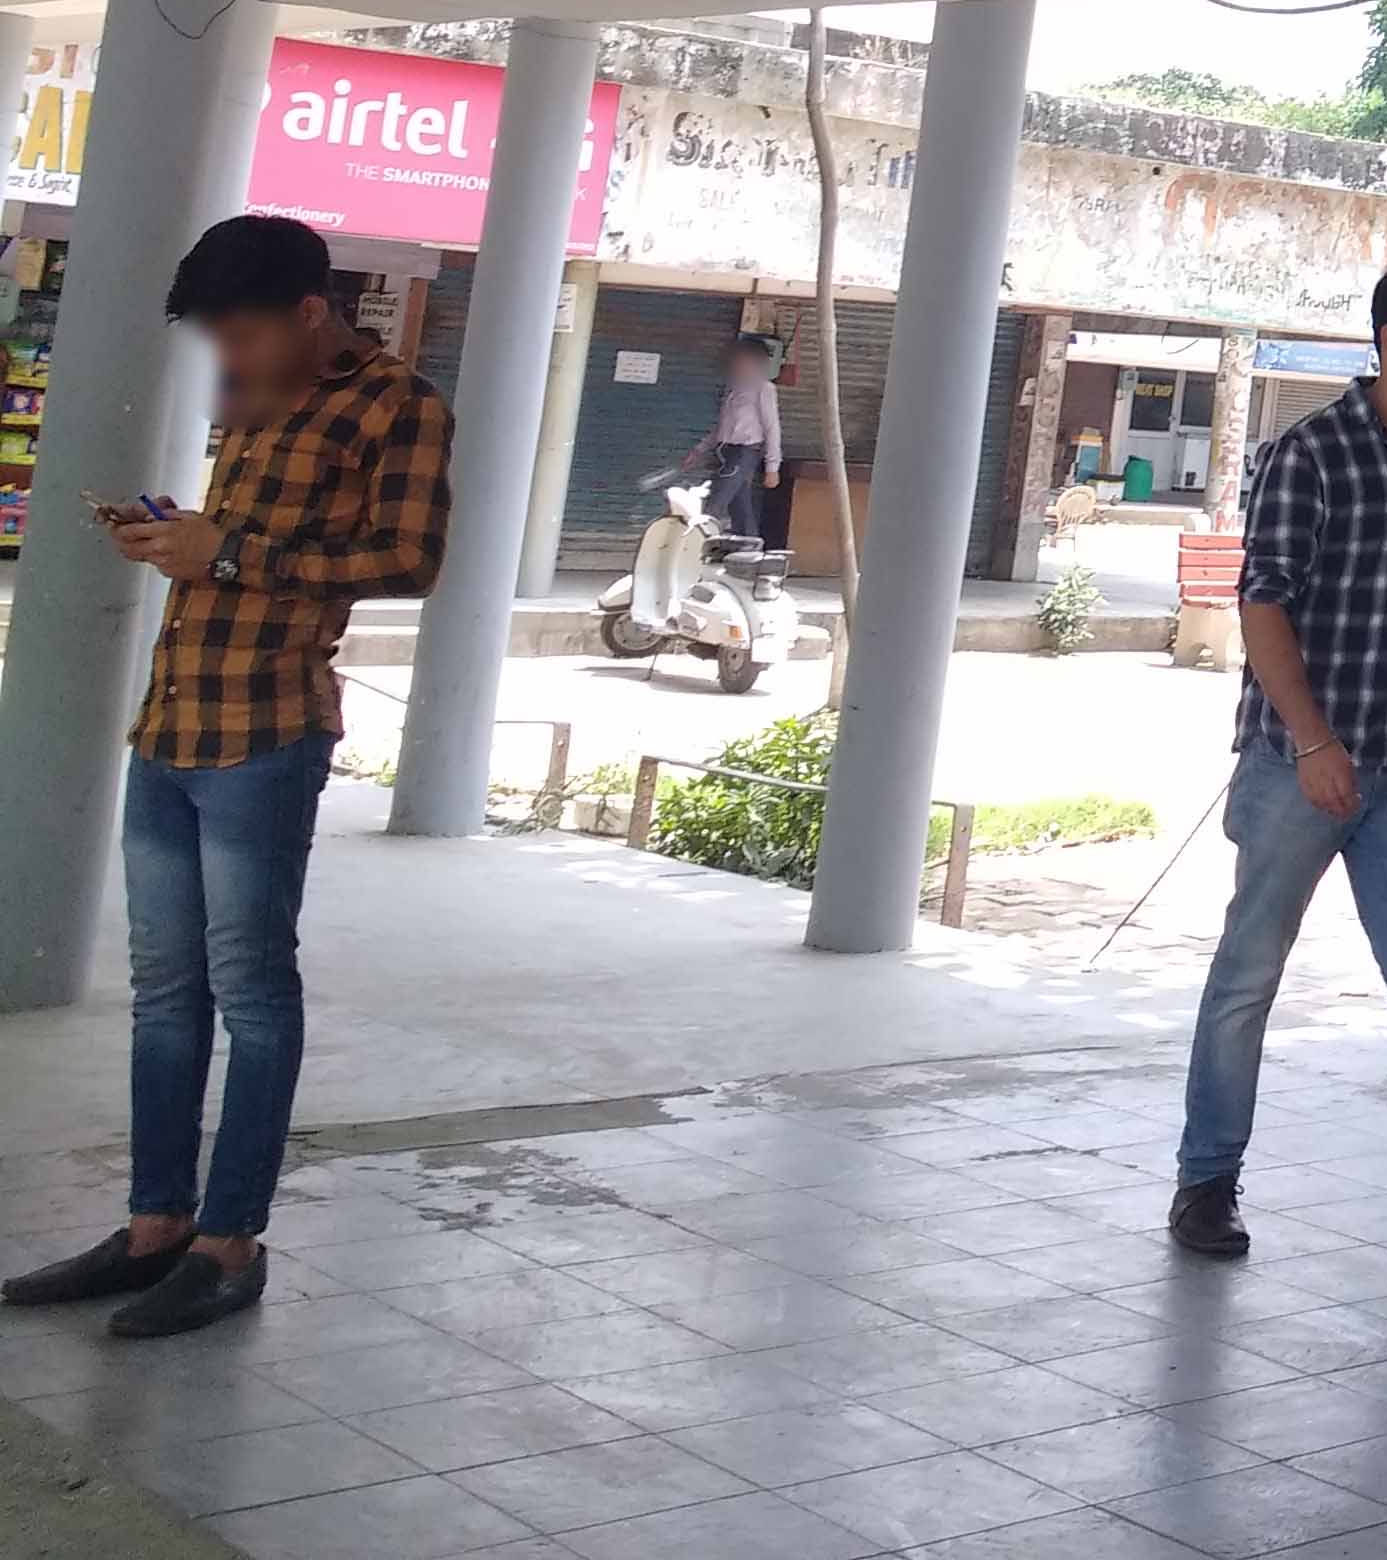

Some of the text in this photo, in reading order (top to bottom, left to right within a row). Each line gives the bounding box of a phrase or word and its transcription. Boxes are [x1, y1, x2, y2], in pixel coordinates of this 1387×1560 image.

[282, 78, 469, 159] airtel
[345, 162, 491, 192] THE SMARTPHON
